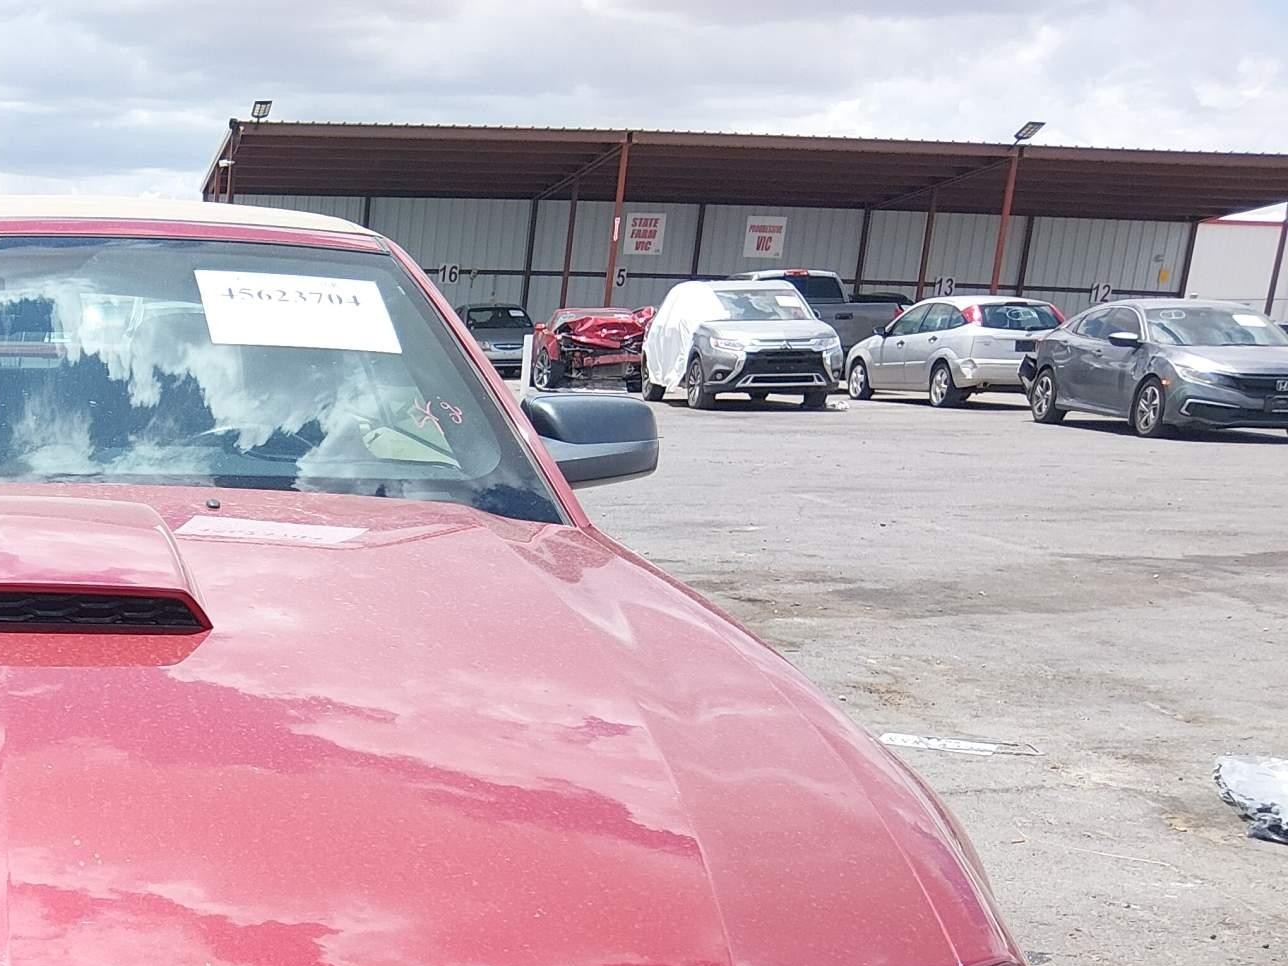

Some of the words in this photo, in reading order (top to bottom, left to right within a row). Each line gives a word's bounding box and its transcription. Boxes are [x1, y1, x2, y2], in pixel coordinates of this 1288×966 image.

[631, 217, 660, 228] STATE
[630, 229, 657, 239] FARM
[634, 240, 652, 251] VIC
[756, 235, 772, 251] VIC
[439, 264, 458, 283] 16
[616, 268, 626, 287] 5
[935, 277, 954, 296] 13
[1093, 283, 1111, 302] 12
